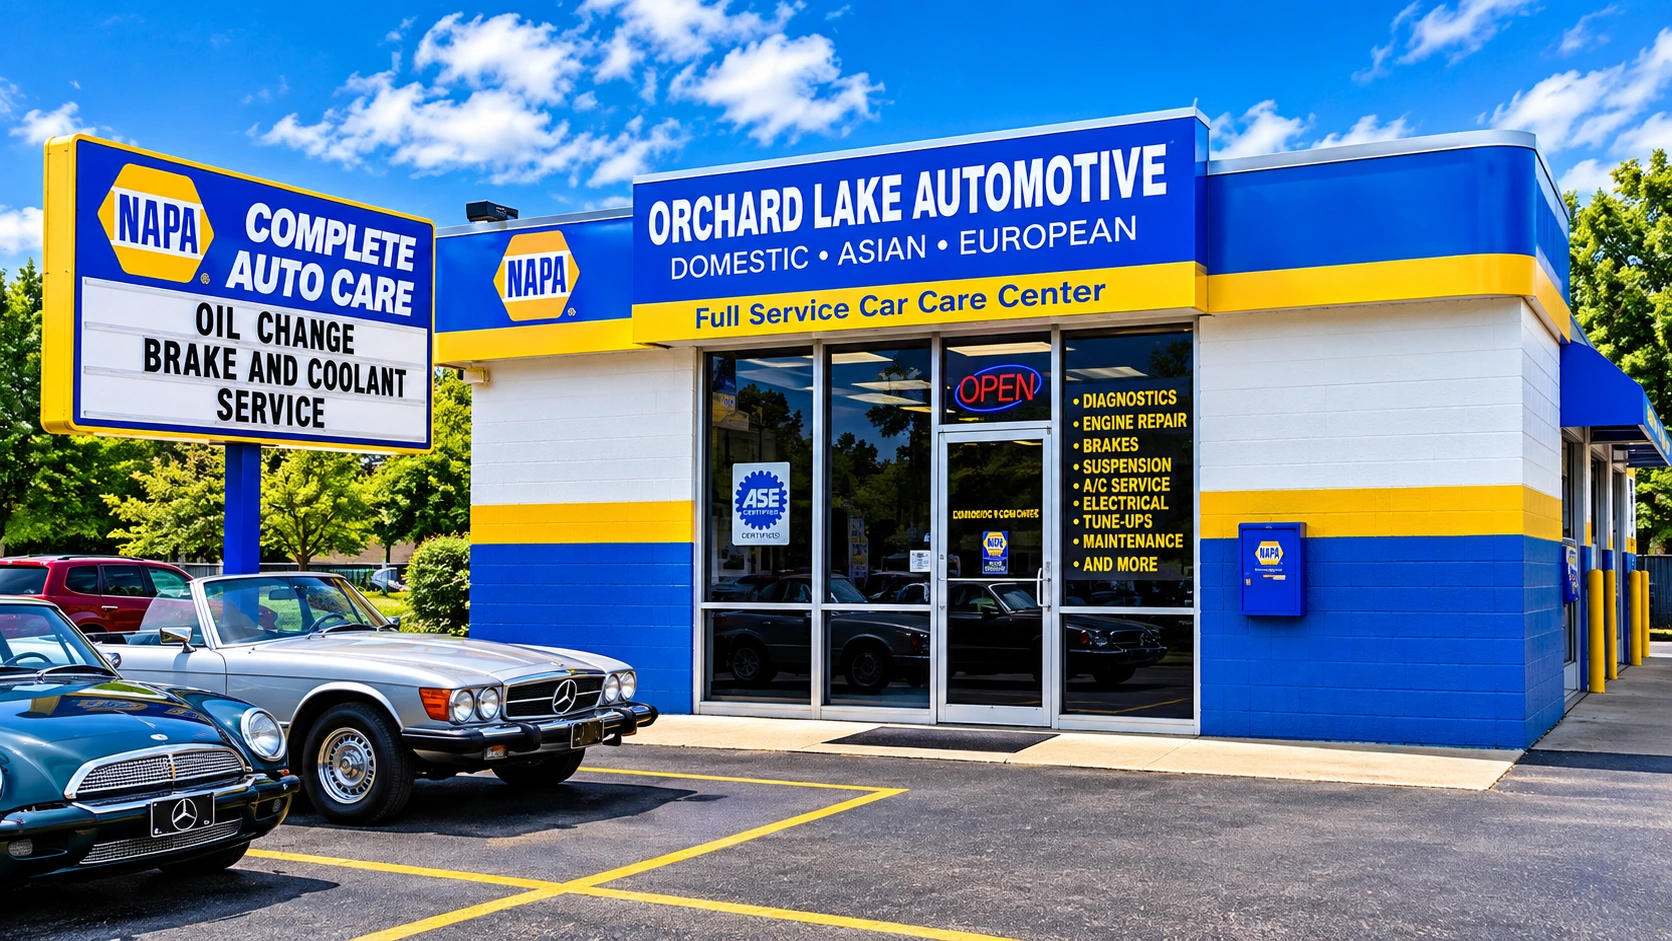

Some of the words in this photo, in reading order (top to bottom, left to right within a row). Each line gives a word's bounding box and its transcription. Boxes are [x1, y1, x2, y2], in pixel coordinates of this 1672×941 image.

[648, 186, 804, 246] ORCHARD
[814, 174, 902, 229] LAKE
[912, 143, 1167, 220] AUTOMOTIVE
[119, 194, 199, 254] NAPA
[245, 202, 417, 272] COMPLETE
[671, 245, 809, 280] DOMESTIC
[837, 234, 926, 266] ASIAN
[960, 215, 1137, 256] EUROPEAN
[225, 250, 325, 301] AUTO
[330, 268, 415, 317] CARE
[507, 255, 567, 298] NAPA
[695, 304, 740, 329] Full
[749, 299, 850, 326] Service
[859, 294, 909, 318] Car
[918, 290, 987, 314] Care
[998, 281, 1106, 308] Center
[196, 302, 241, 341] OIL
[257, 311, 355, 355] CHANGE
[143, 338, 237, 381] BRAKE
[248, 351, 298, 387] AND
[307, 359, 407, 399] COOLANT
[959, 372, 1035, 404] OPEN
[1083, 389, 1178, 409] DIAGNOSTICS
[216, 388, 326, 429] SERVICE
[1083, 413, 1134, 431] ENGINE
[1138, 412, 1187, 429] REPAIR
[1083, 437, 1139, 453] BRAKES
[1083, 457, 1172, 474] SUSPENSION
[1083, 478, 1107, 493] A/C
[1111, 476, 1171, 493] SERVICE
[742, 488, 780, 509] ASE
[1083, 495, 1169, 511] ELECTRICAL
[1083, 513, 1153, 529] TUNE-UPS
[1083, 533, 1184, 549] MAINTENANCE
[1260, 547, 1280, 559] NAPA
[1083, 557, 1113, 572] AND
[1117, 556, 1158, 572] MORE
